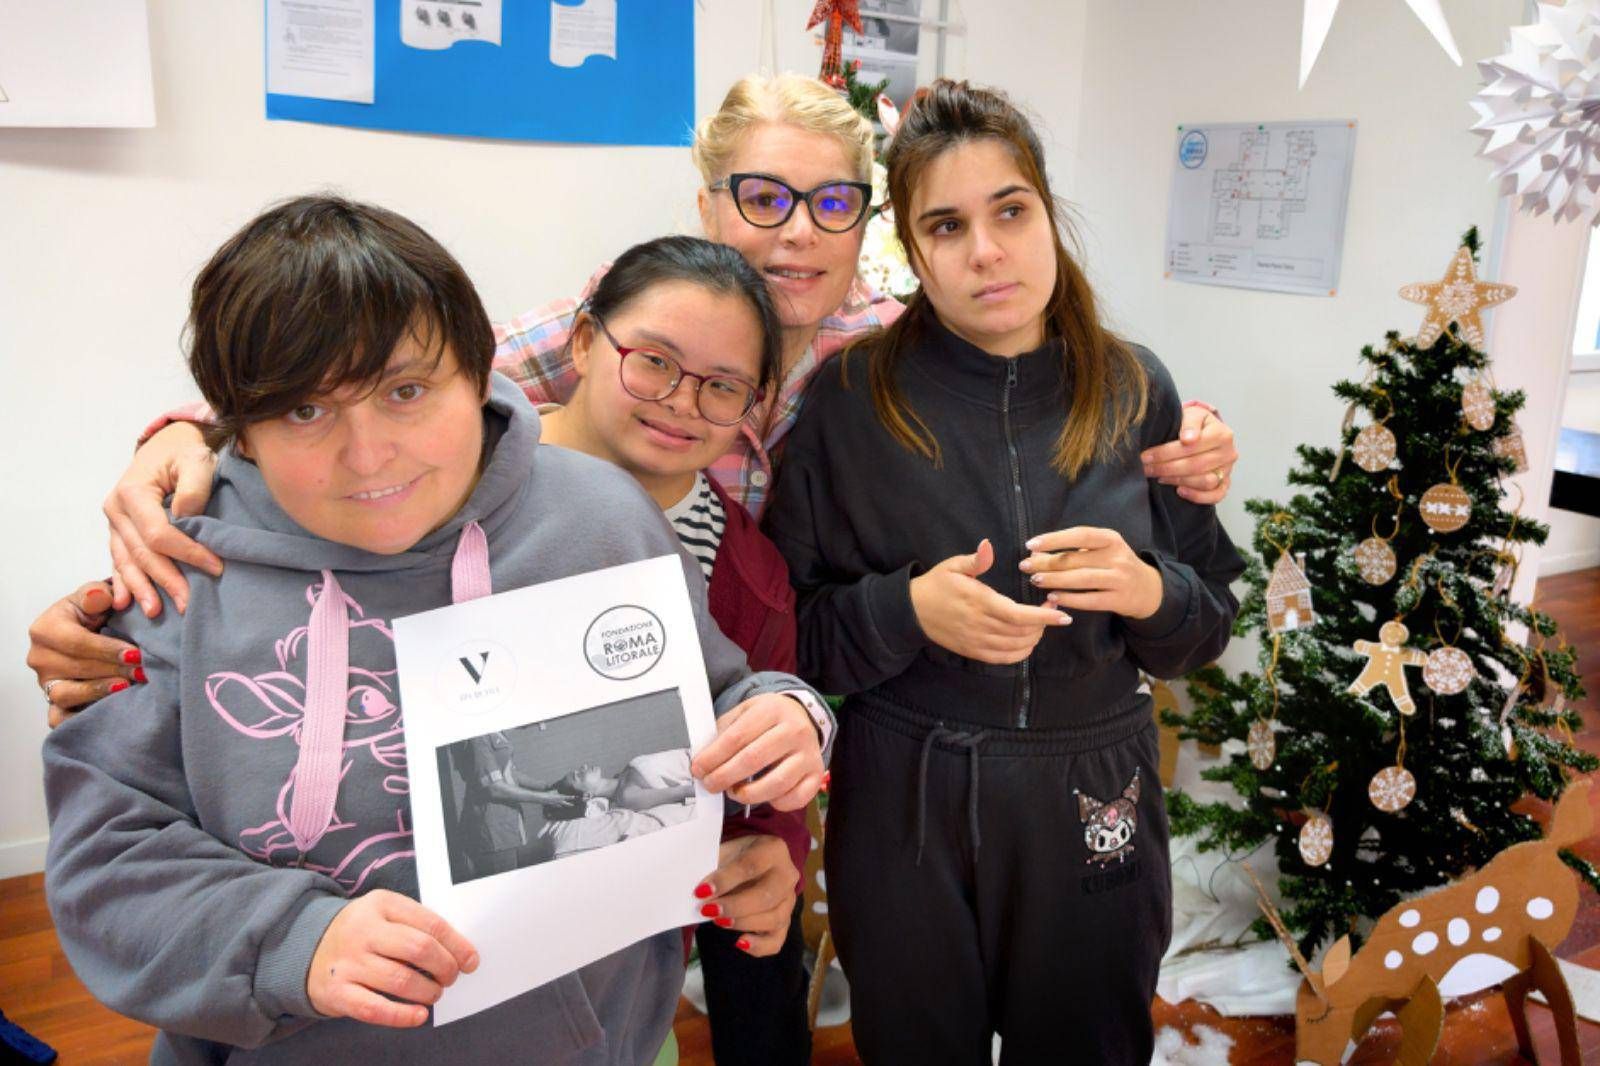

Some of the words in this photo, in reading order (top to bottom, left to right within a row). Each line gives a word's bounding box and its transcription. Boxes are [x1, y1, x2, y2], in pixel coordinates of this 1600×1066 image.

[603, 632, 657, 655] ROMA
[458, 650, 490, 685] V
[605, 645, 660, 667] LITORALE
